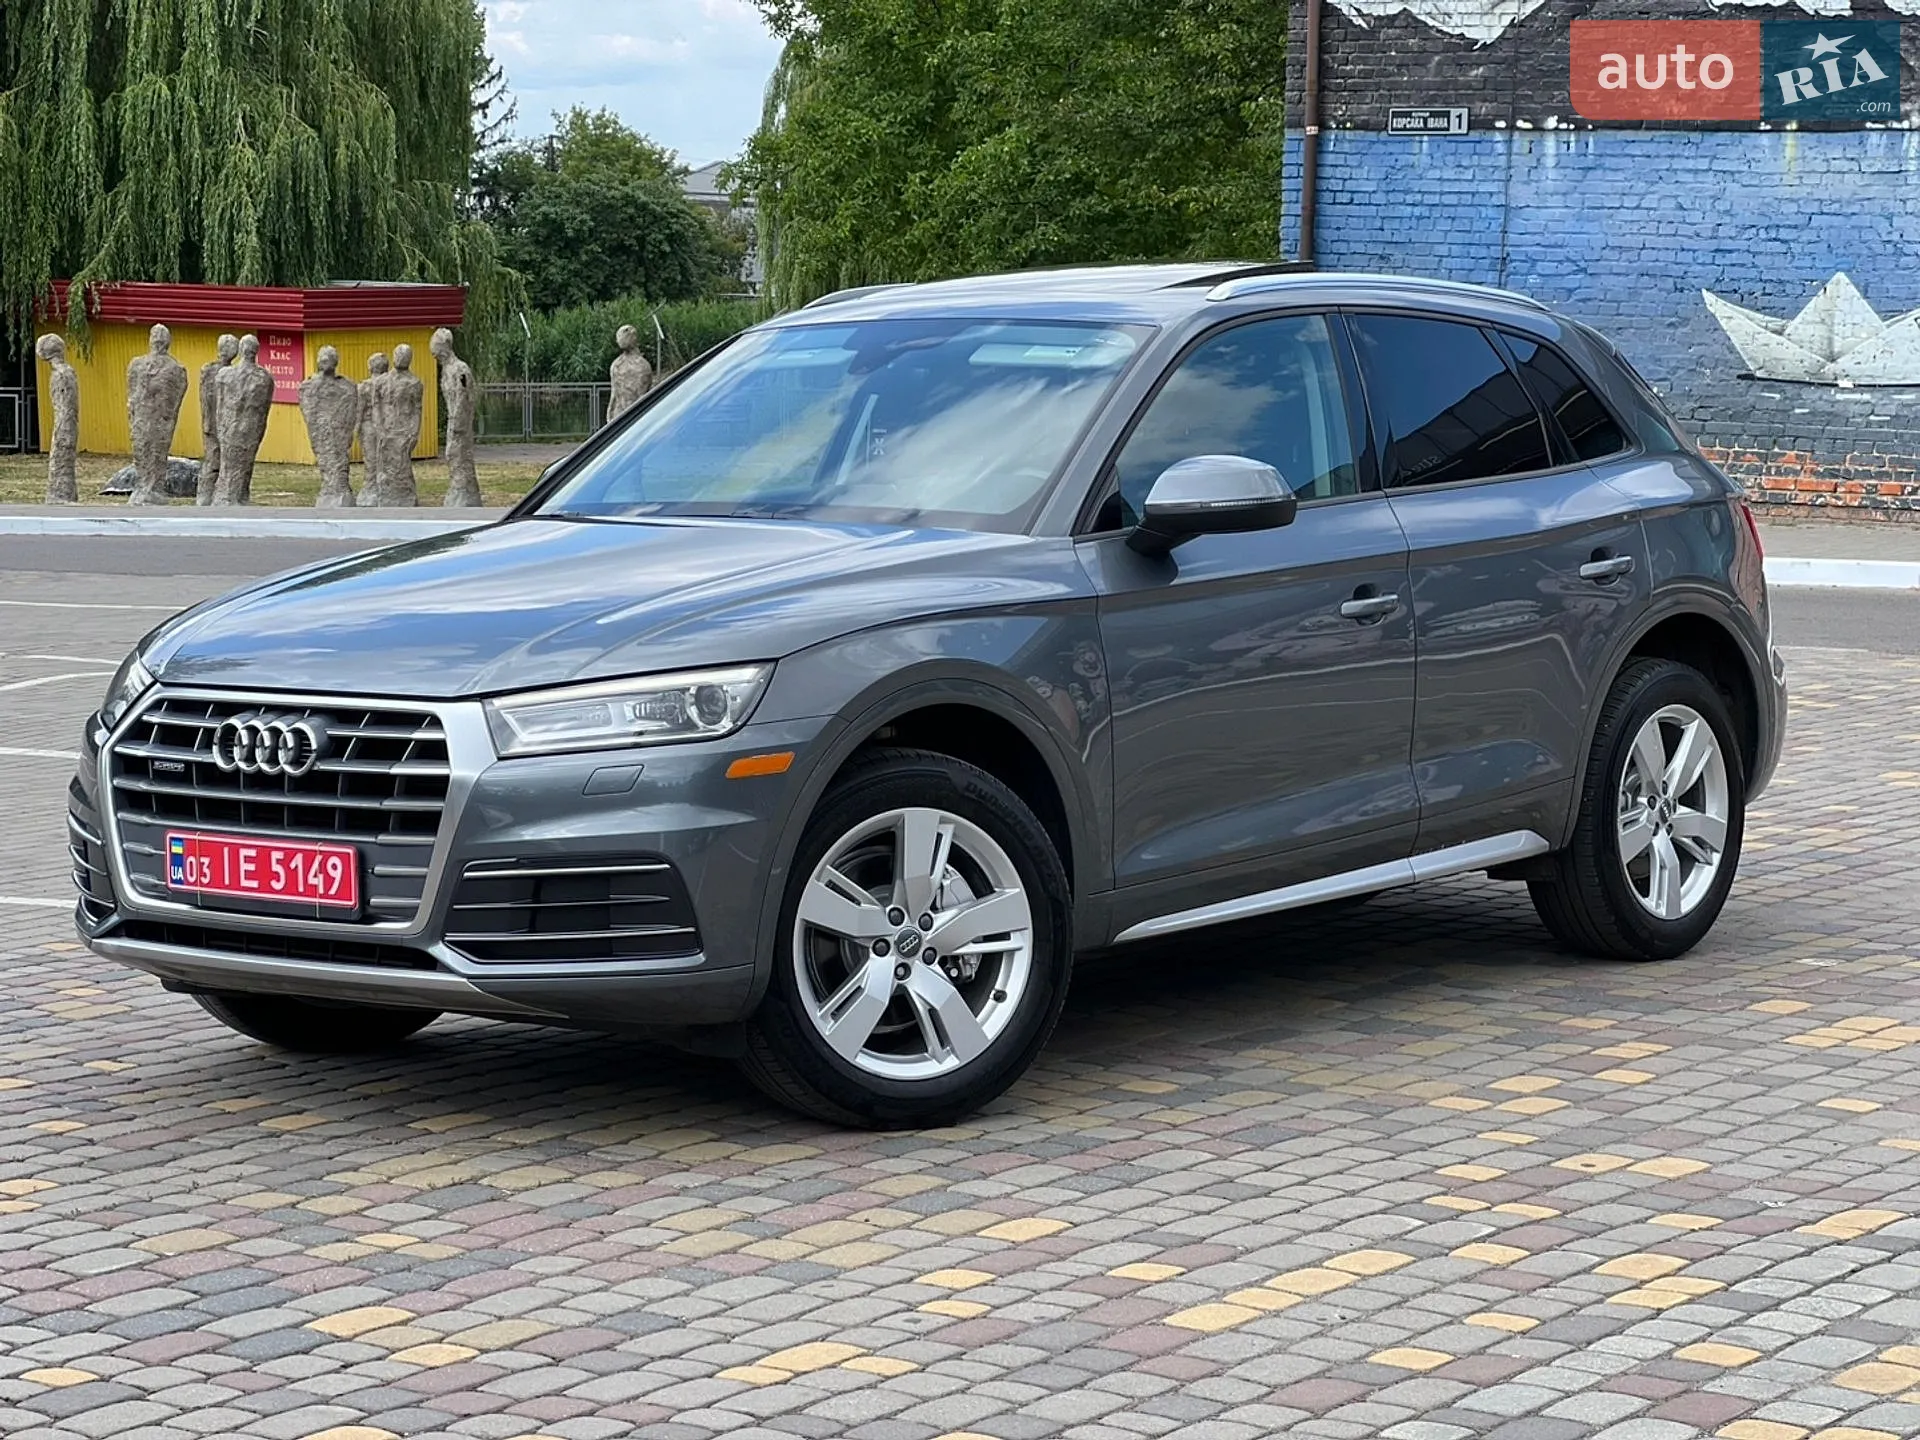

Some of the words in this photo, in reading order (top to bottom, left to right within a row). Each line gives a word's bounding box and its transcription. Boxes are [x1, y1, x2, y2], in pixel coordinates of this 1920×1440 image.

[1455, 112, 1462, 130] 1
[170, 866, 184, 881] UA
[186, 855, 211, 884] 03
[223, 847, 260, 889] IE
[269, 850, 343, 896] 5149
